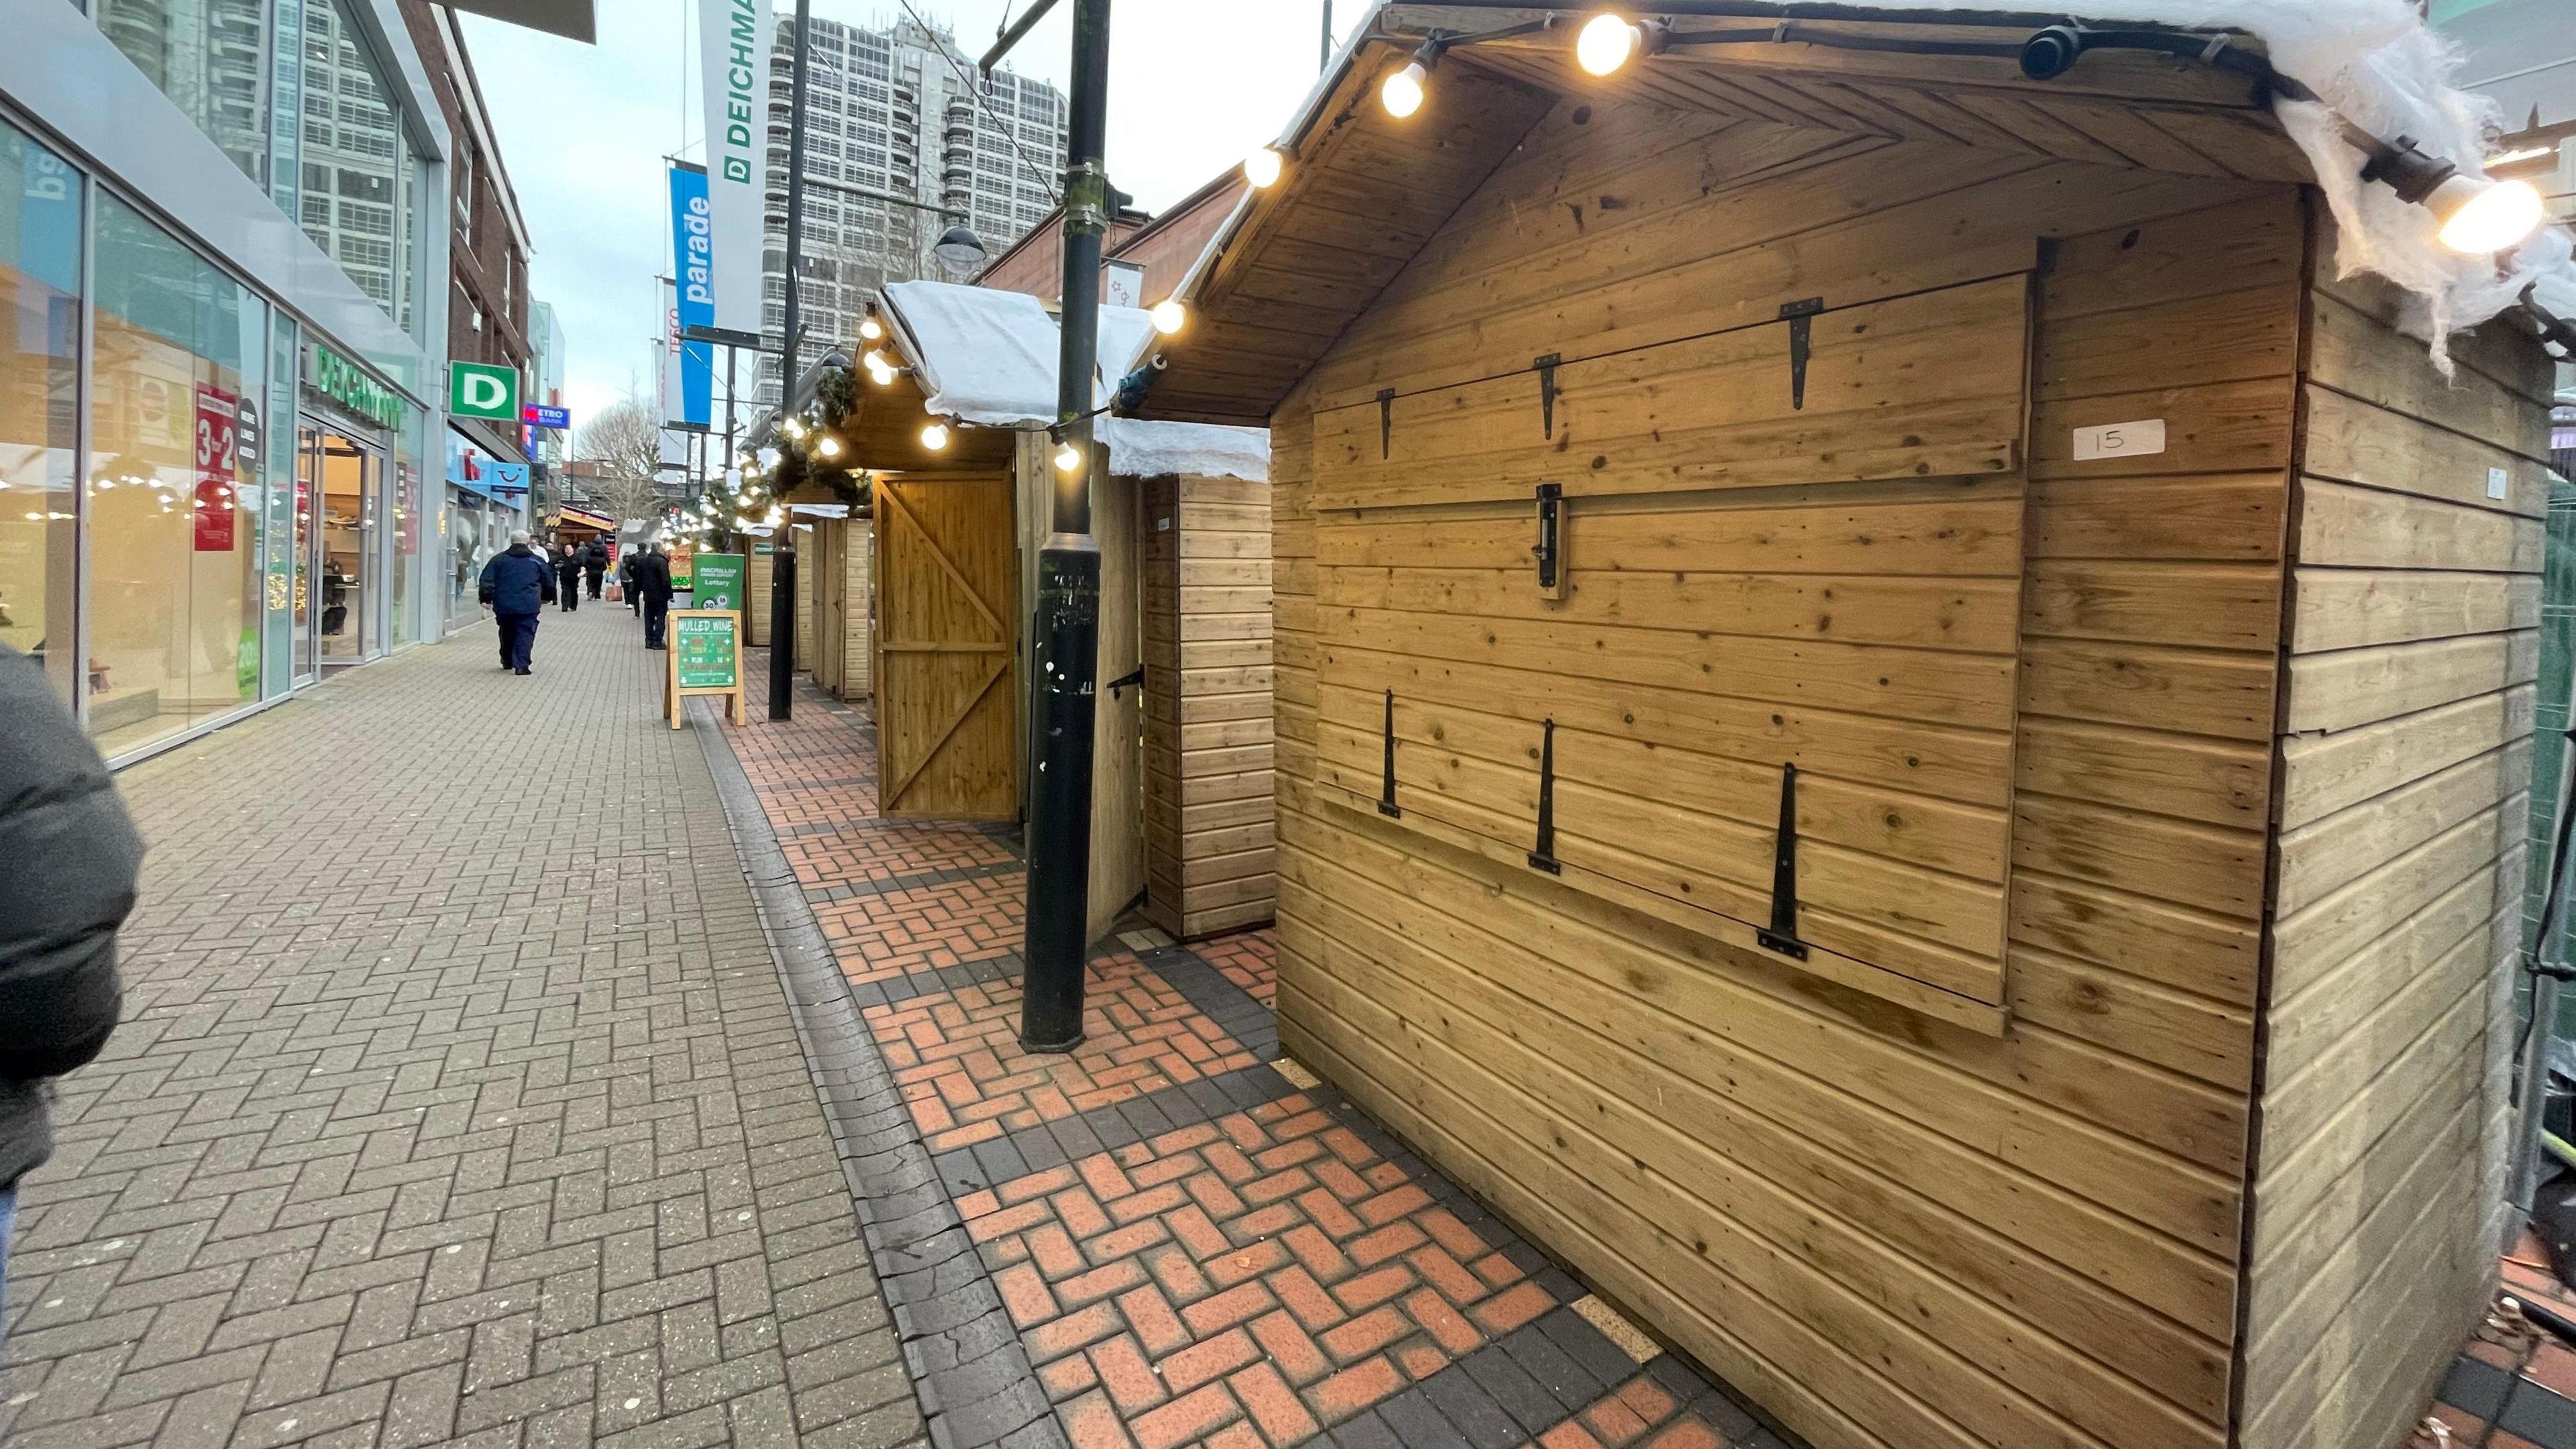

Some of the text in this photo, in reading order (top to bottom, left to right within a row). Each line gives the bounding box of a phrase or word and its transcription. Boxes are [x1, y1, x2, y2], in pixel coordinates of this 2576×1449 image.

[683, 197, 714, 305] parade
[464, 373, 507, 409] D
[198, 419, 211, 466] 3
[221, 426, 234, 470] 2
[2096, 430, 2125, 451] 15
[678, 620, 733, 632] MULLED WINE
